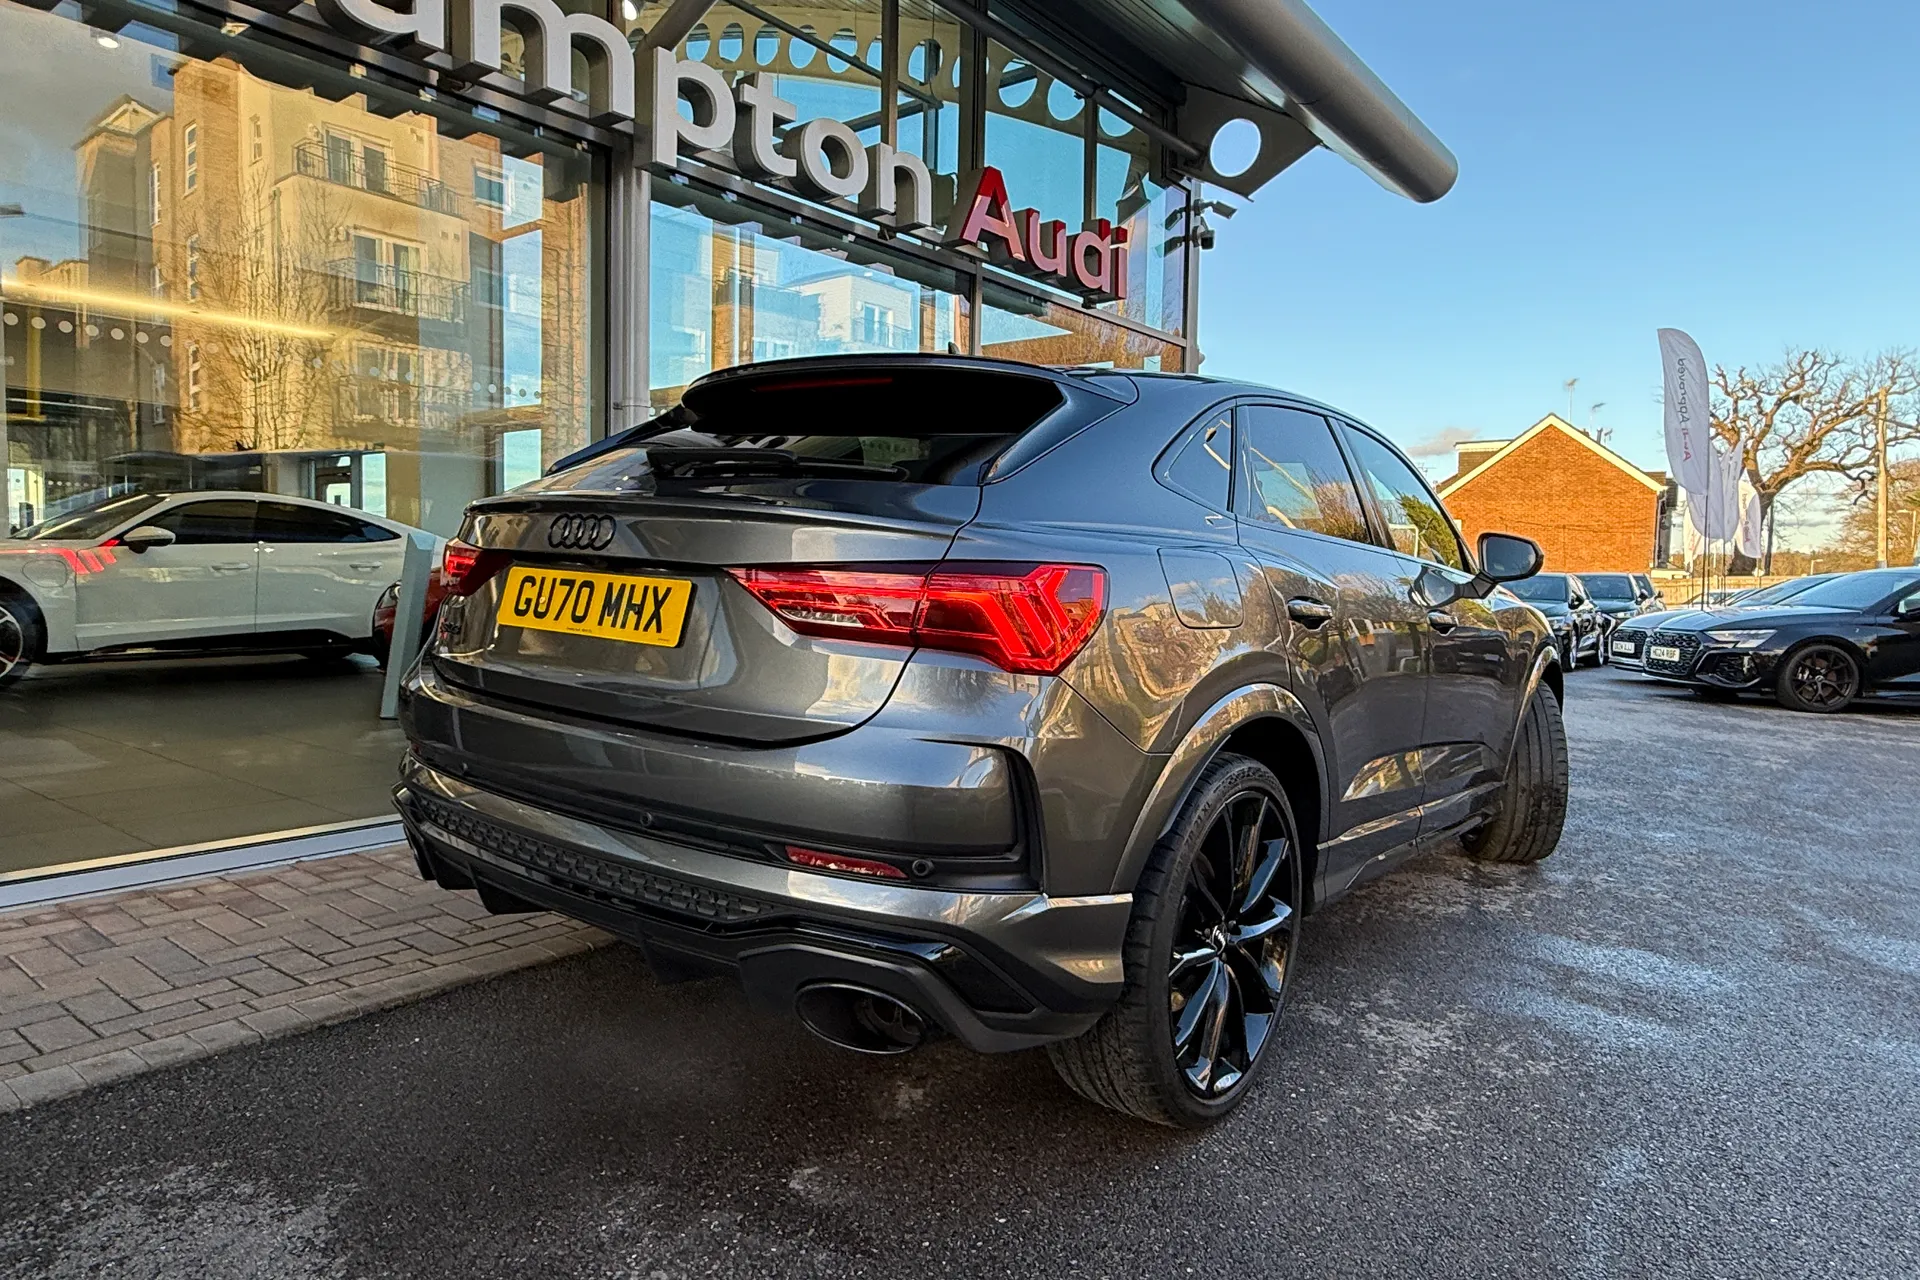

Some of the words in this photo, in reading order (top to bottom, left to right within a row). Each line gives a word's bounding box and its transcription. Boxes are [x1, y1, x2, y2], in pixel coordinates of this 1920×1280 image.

[953, 166, 1128, 299] Audi
[513, 575, 595, 624] GU70
[597, 582, 672, 634] MHX
